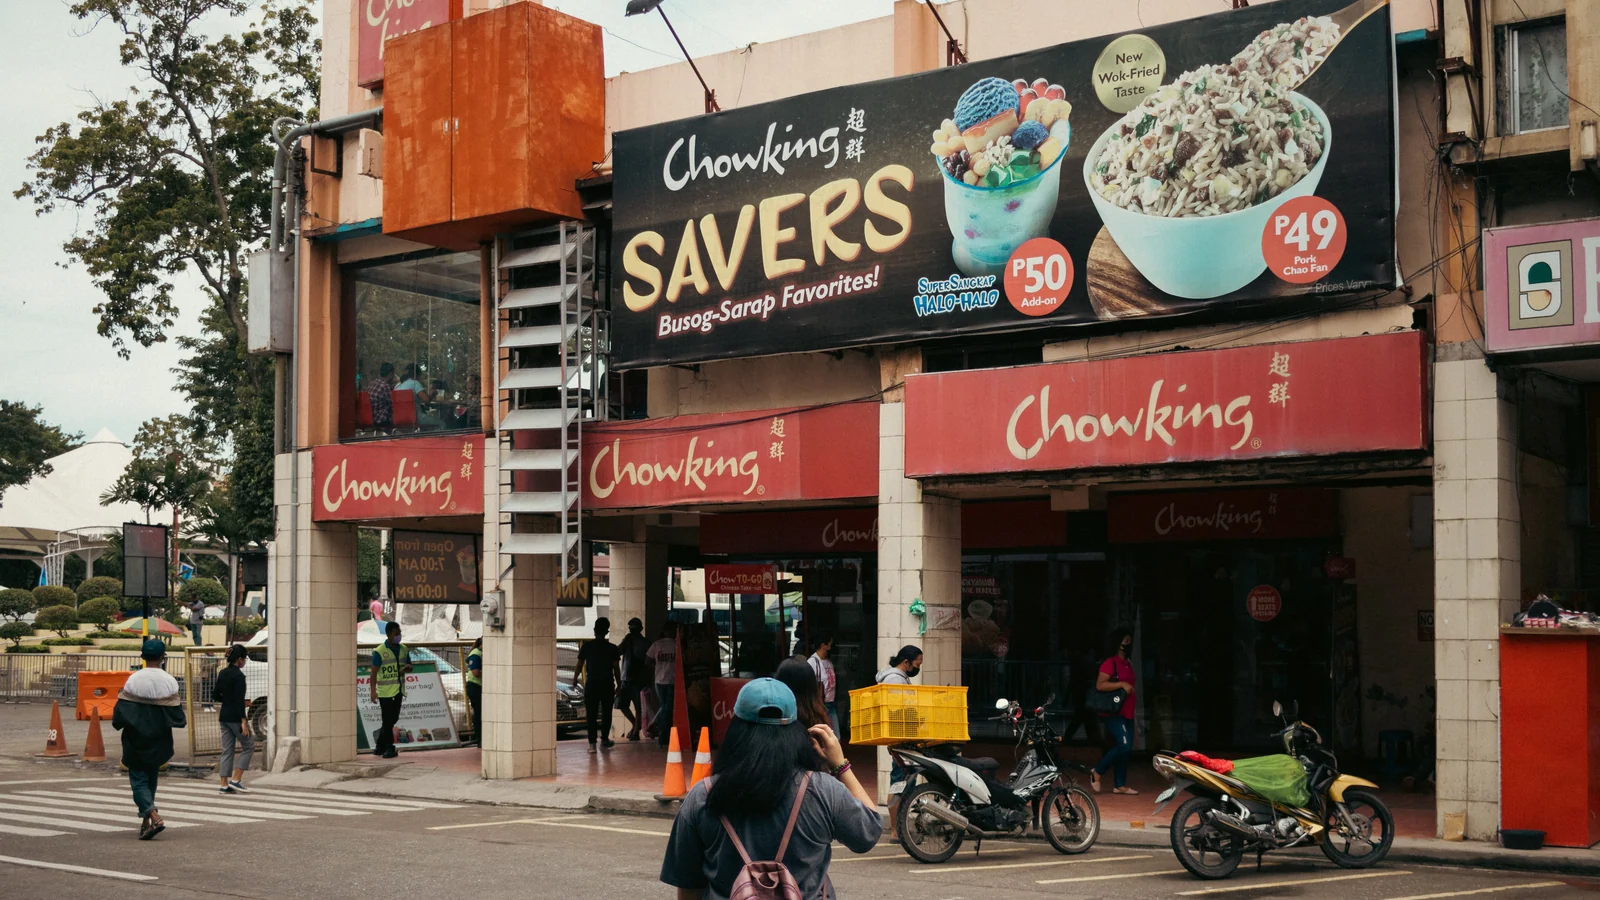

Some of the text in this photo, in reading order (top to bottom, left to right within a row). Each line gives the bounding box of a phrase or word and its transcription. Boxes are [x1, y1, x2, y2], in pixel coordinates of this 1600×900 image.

[1098, 63, 1160, 84] Wok-Fried
[1115, 53, 1143, 65] New
[1113, 86, 1145, 98] Taste
[845, 107, 867, 163] 超群
[663, 121, 840, 192] Chowking
[622, 164, 915, 312] SAVERS
[1283, 264, 1328, 276] Chao Fan
[1294, 254, 1317, 265] Pork
[658, 265, 880, 337] Busog-Sarap Favorites!
[1021, 296, 1057, 308] Add-on
[1315, 282, 1344, 293] Prices
[913, 289, 1000, 317] HALO-HALO
[1268, 352, 1291, 408] 超群
[1006, 379, 1254, 460] Chowking
[589, 436, 759, 499] Chowking
[322, 457, 453, 513] Chowking
[822, 518, 878, 548] Chowk
[1154, 502, 1263, 535] Chowking
[1257, 603, 1276, 611] SEATS
[1258, 595, 1275, 603] MORE
